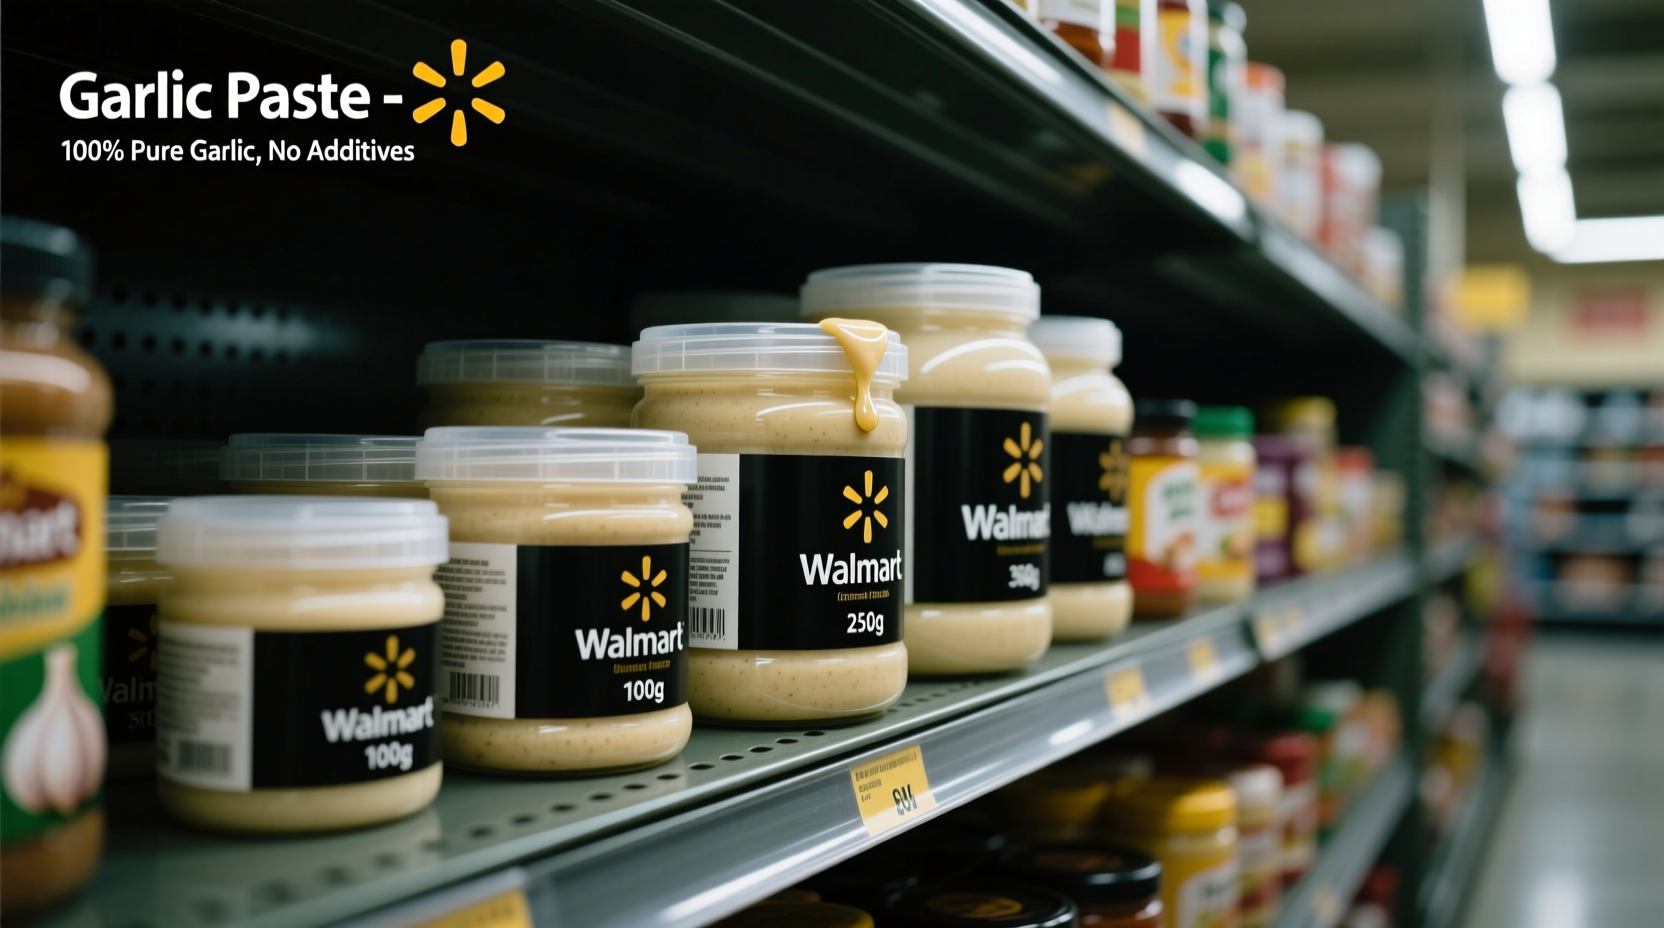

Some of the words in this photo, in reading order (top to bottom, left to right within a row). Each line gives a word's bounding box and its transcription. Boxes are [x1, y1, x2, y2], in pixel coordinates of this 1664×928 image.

[799, 549, 902, 586] Walmart
[846, 611, 884, 637] 250g
[575, 621, 684, 661] Walmart
[623, 678, 665, 704] 100g
[320, 695, 434, 743] Walmart
[364, 741, 413, 771] 100g
